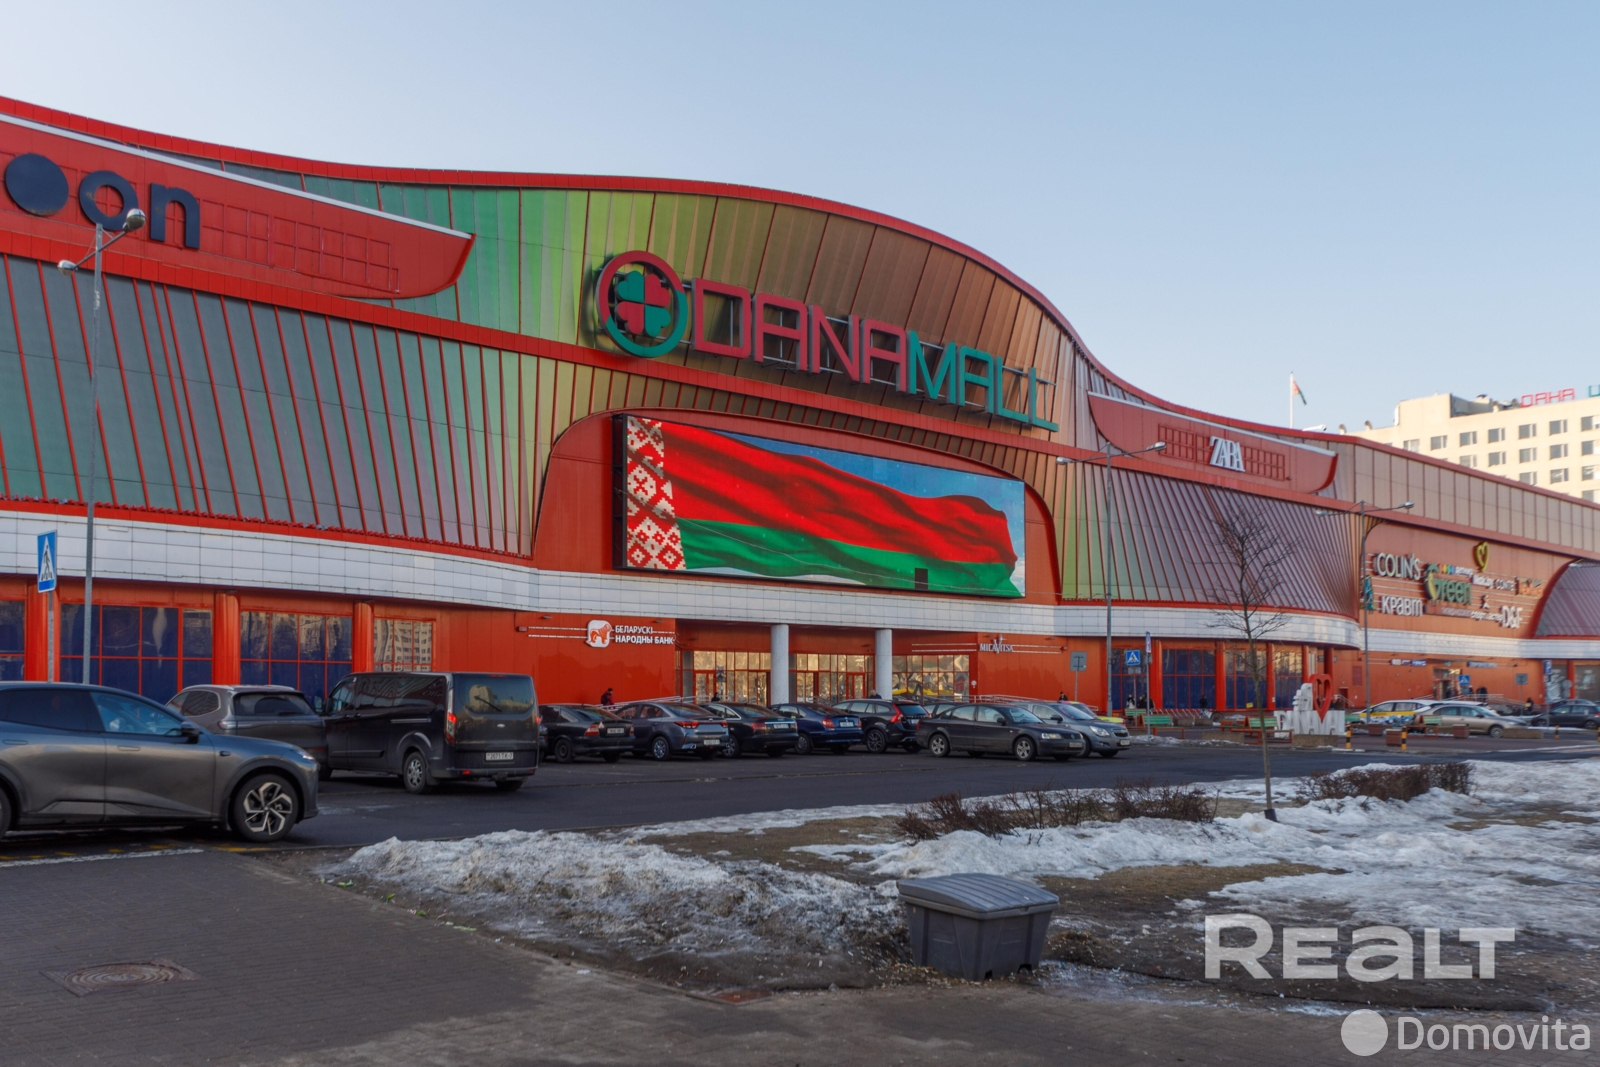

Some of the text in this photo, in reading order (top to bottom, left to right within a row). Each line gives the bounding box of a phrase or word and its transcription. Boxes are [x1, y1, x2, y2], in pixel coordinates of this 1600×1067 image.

[1209, 435, 1246, 472] ZARA
[1377, 552, 1421, 581] COLIN'S
[615, 635, 675, 645] НАРОДНЫ БАНК
